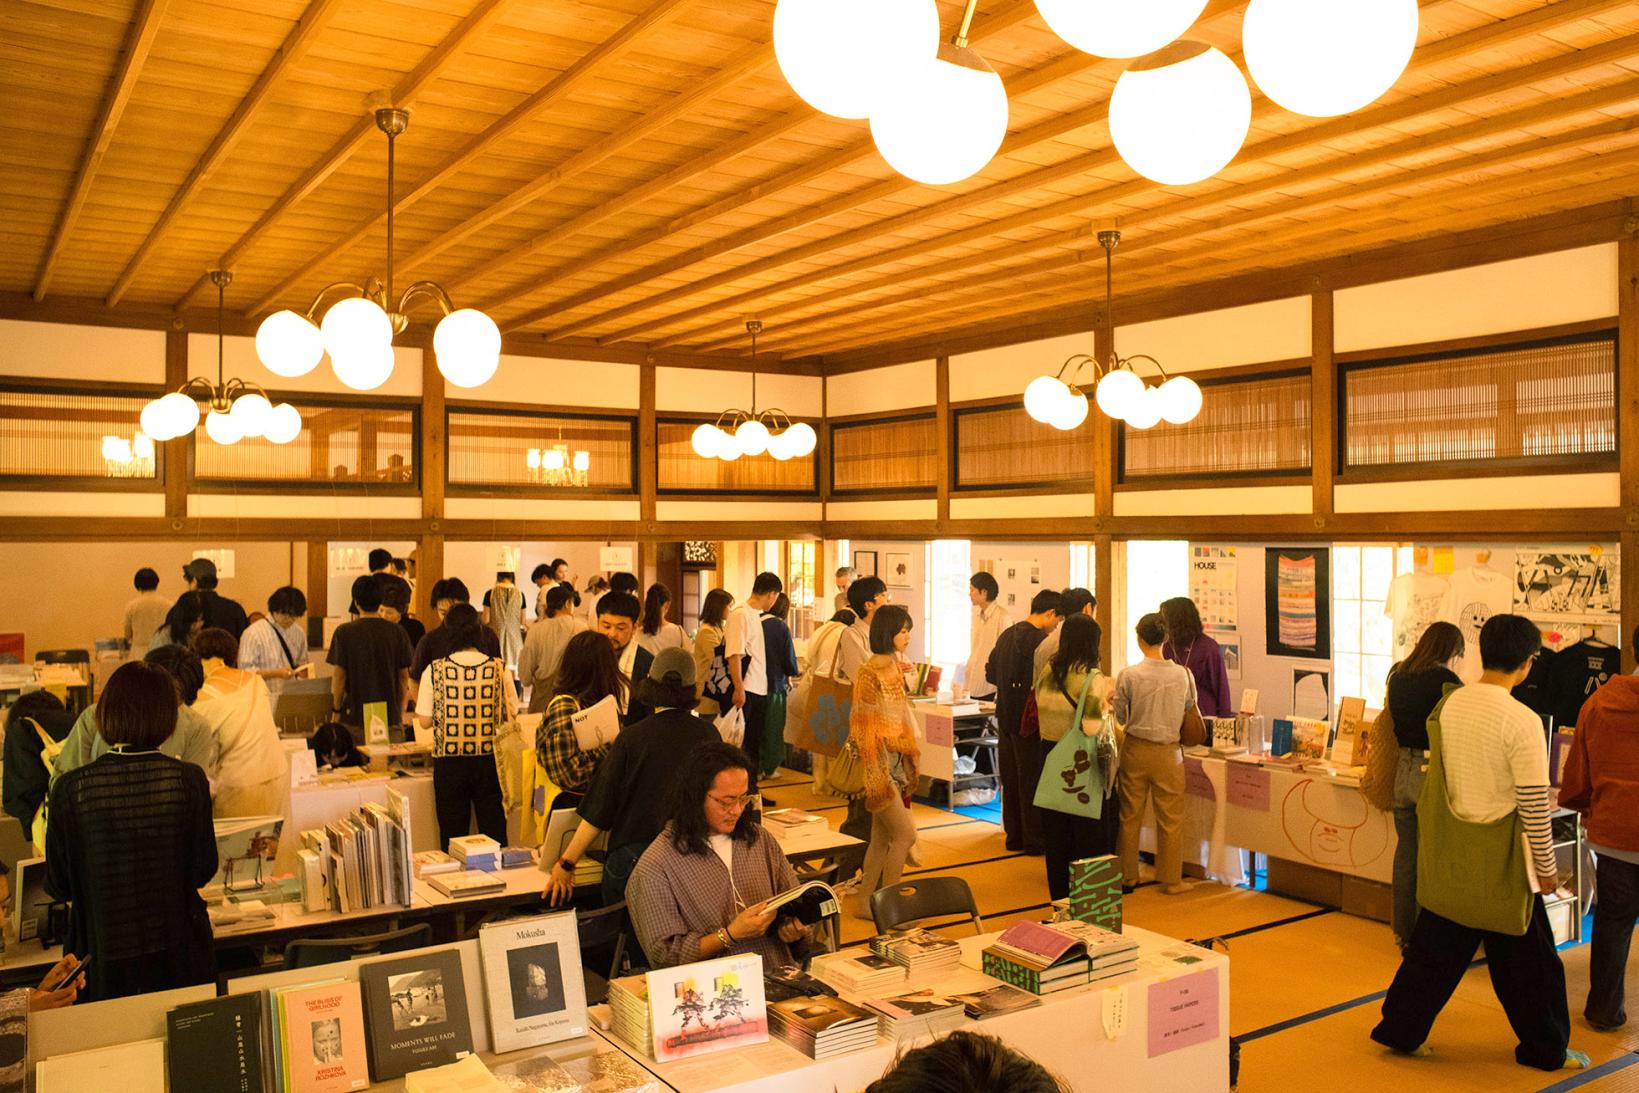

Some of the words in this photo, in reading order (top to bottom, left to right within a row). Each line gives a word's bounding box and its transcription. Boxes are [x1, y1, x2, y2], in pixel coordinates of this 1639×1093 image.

[1194, 561, 1216, 570] HOUSE
[575, 714, 588, 722] NOT
[516, 928, 546, 940] Mokusha
[390, 1039, 423, 1050] MOMENTS
[424, 1035, 439, 1043] WILL
[440, 1032, 456, 1041] FADE
